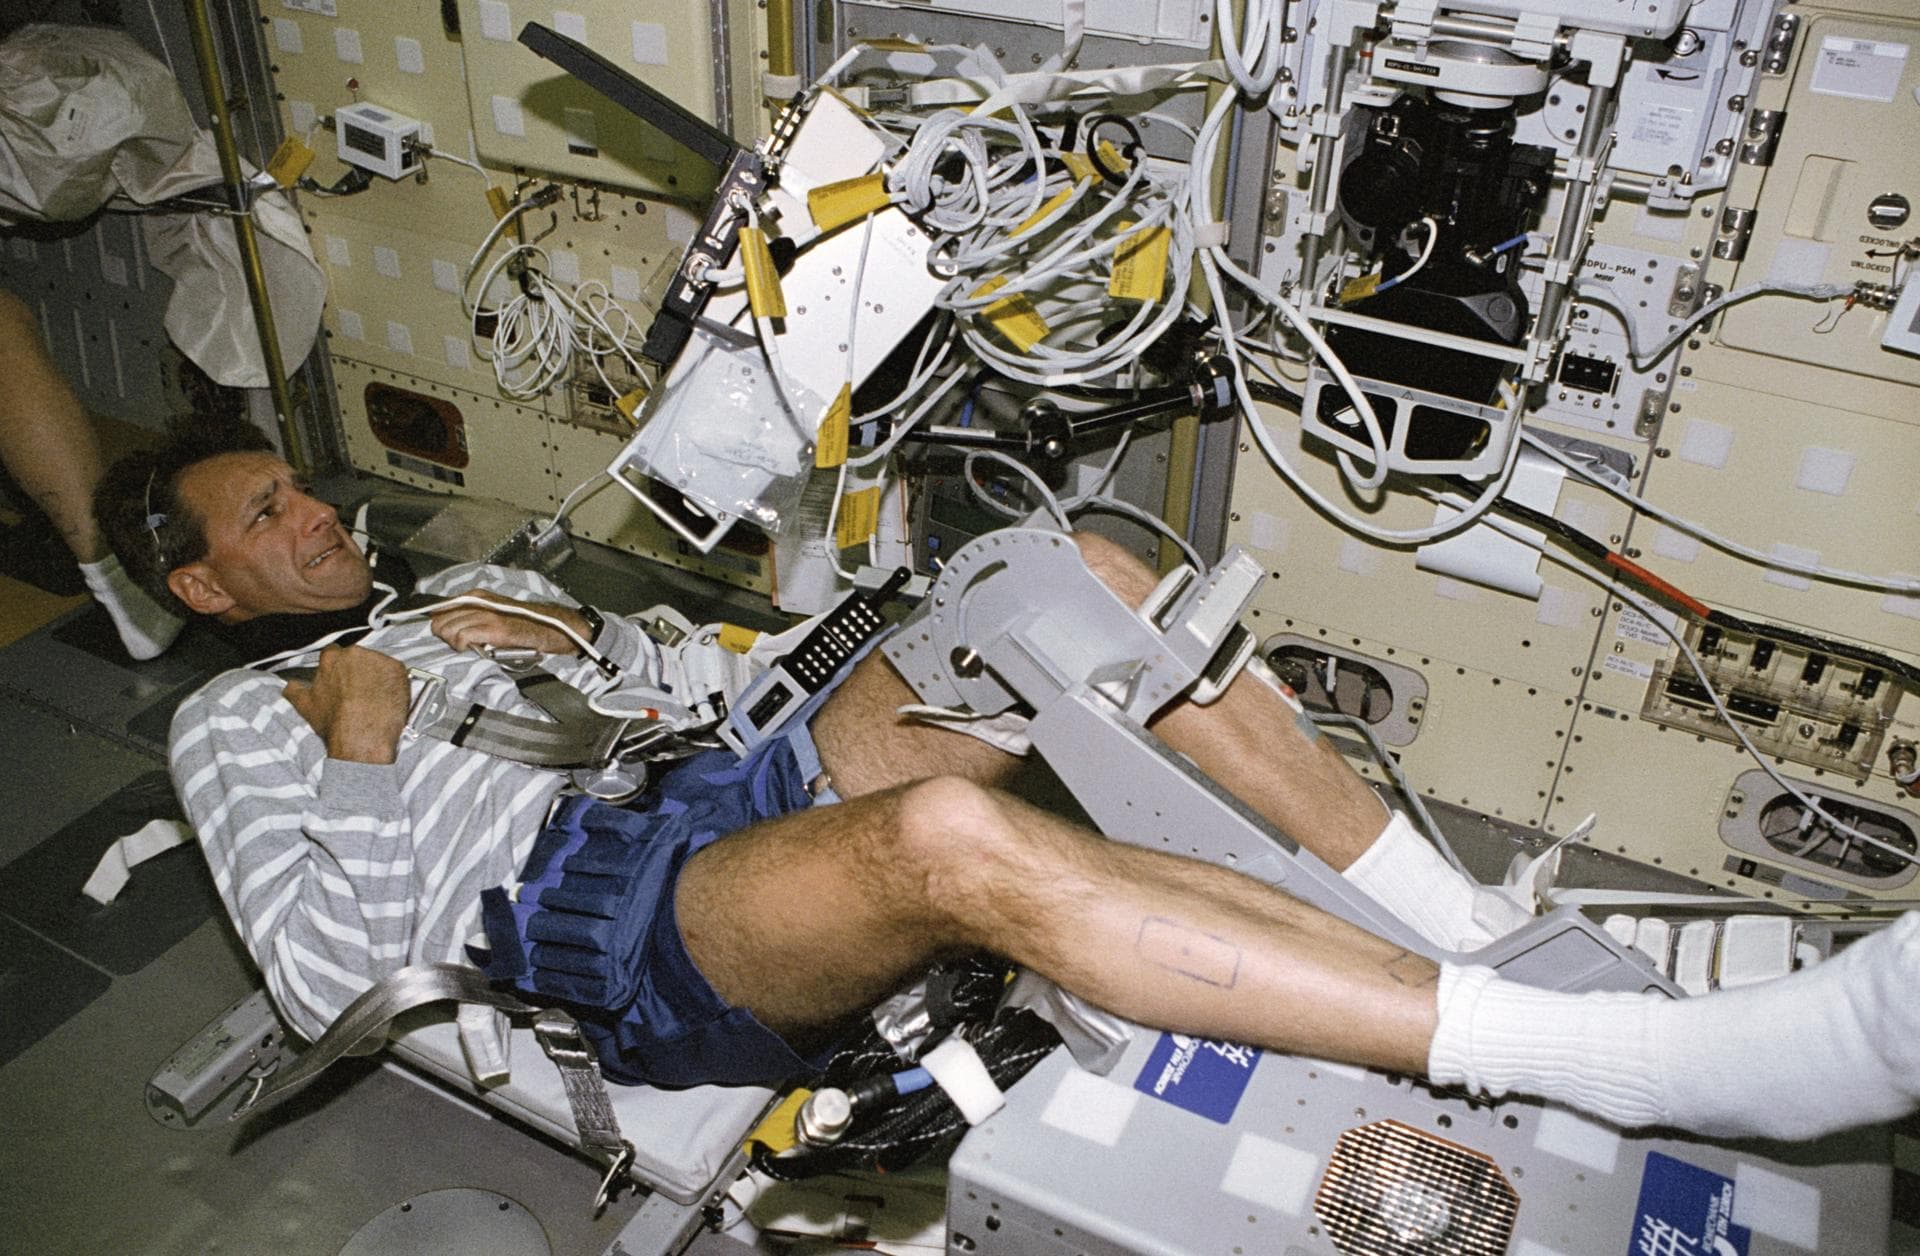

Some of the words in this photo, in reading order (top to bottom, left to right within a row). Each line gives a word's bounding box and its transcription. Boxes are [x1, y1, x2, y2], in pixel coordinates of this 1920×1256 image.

[1859, 235, 1900, 248] UNLOCKED
[1615, 265, 1636, 276] PSM
[1851, 260, 1891, 273] UNLOCKED
